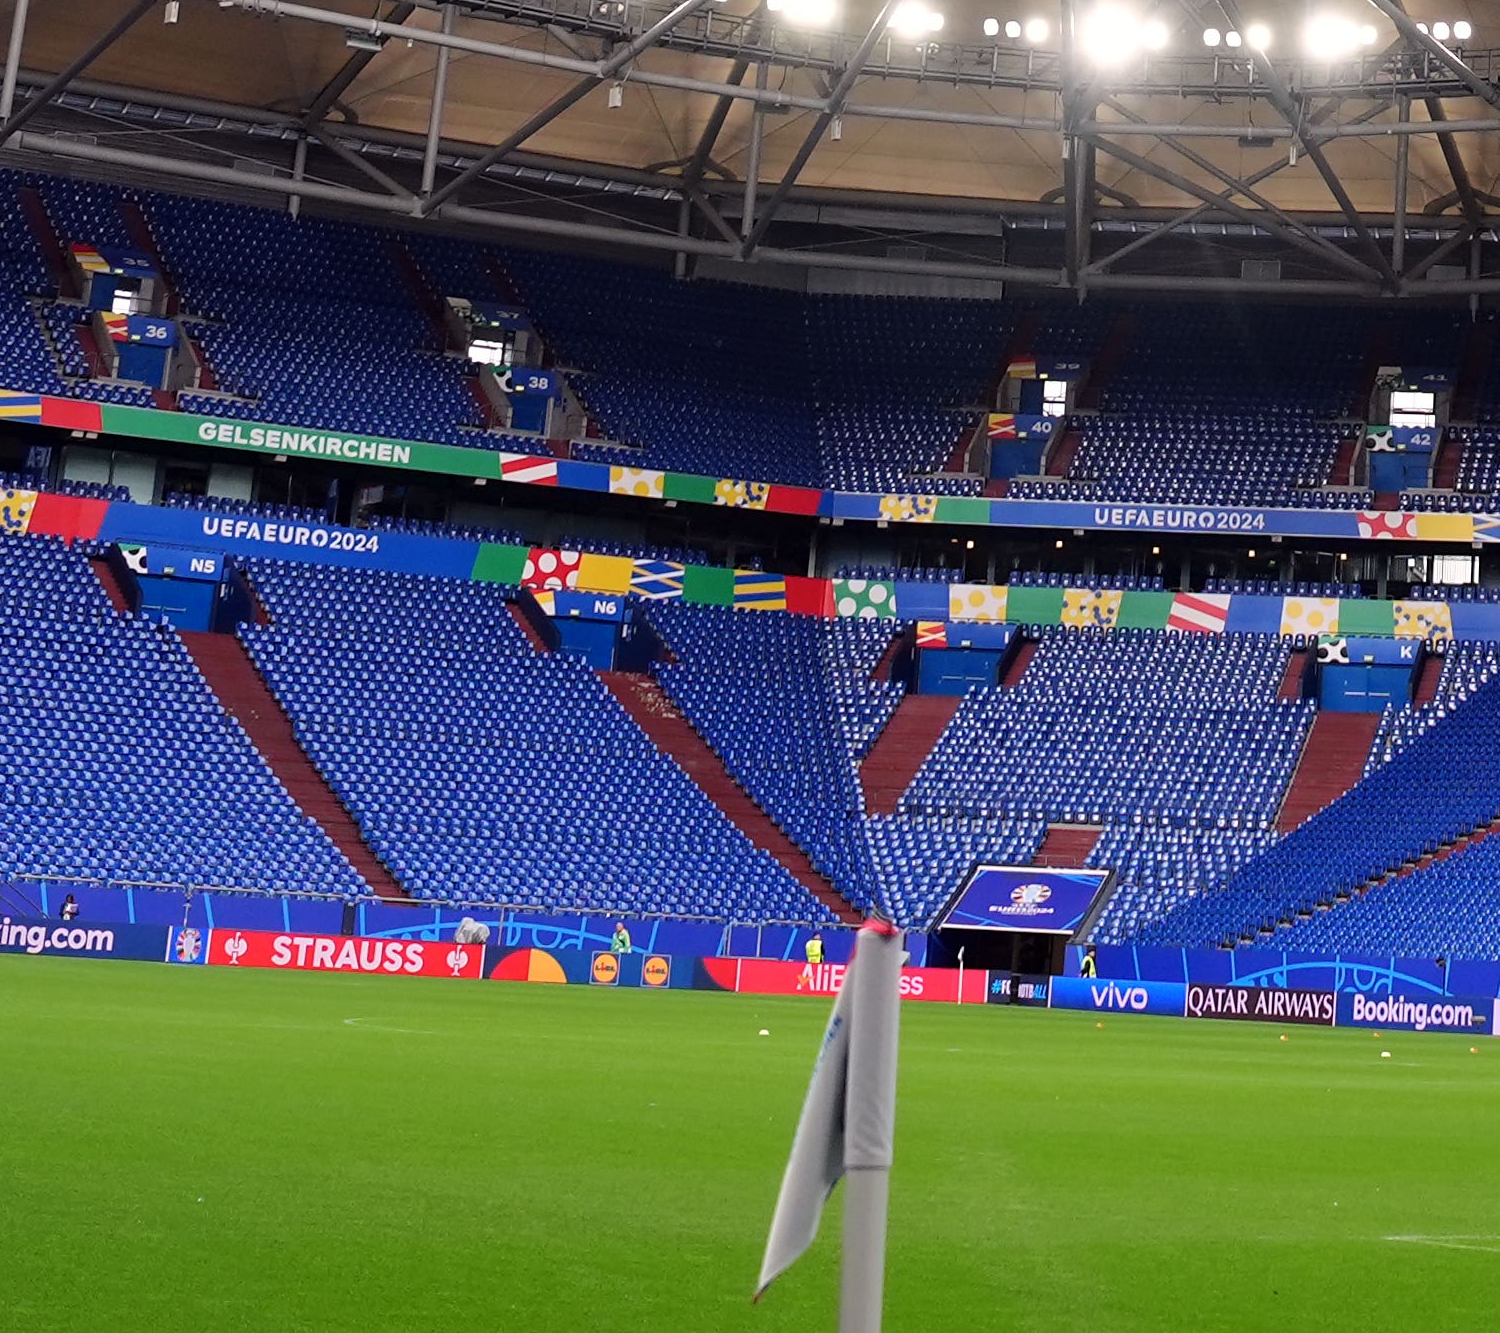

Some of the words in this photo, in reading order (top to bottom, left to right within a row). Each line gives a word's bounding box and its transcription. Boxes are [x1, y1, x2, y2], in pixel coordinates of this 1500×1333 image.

[145, 324, 168, 340] 36
[528, 376, 549, 390] 38
[1031, 420, 1052, 434] 40
[198, 420, 411, 464] GELSENKIRCHEN
[1410, 433, 1431, 446] 42
[190, 558, 215, 574] N5
[594, 600, 617, 615] N6
[1400, 645, 1413, 659] K
[271, 936, 424, 973] STRAUSS
[1188, 986, 1249, 1015] QATAR
[1255, 991, 1333, 1019] AIRWAYS
[1353, 993, 1473, 1031] Booking.com
